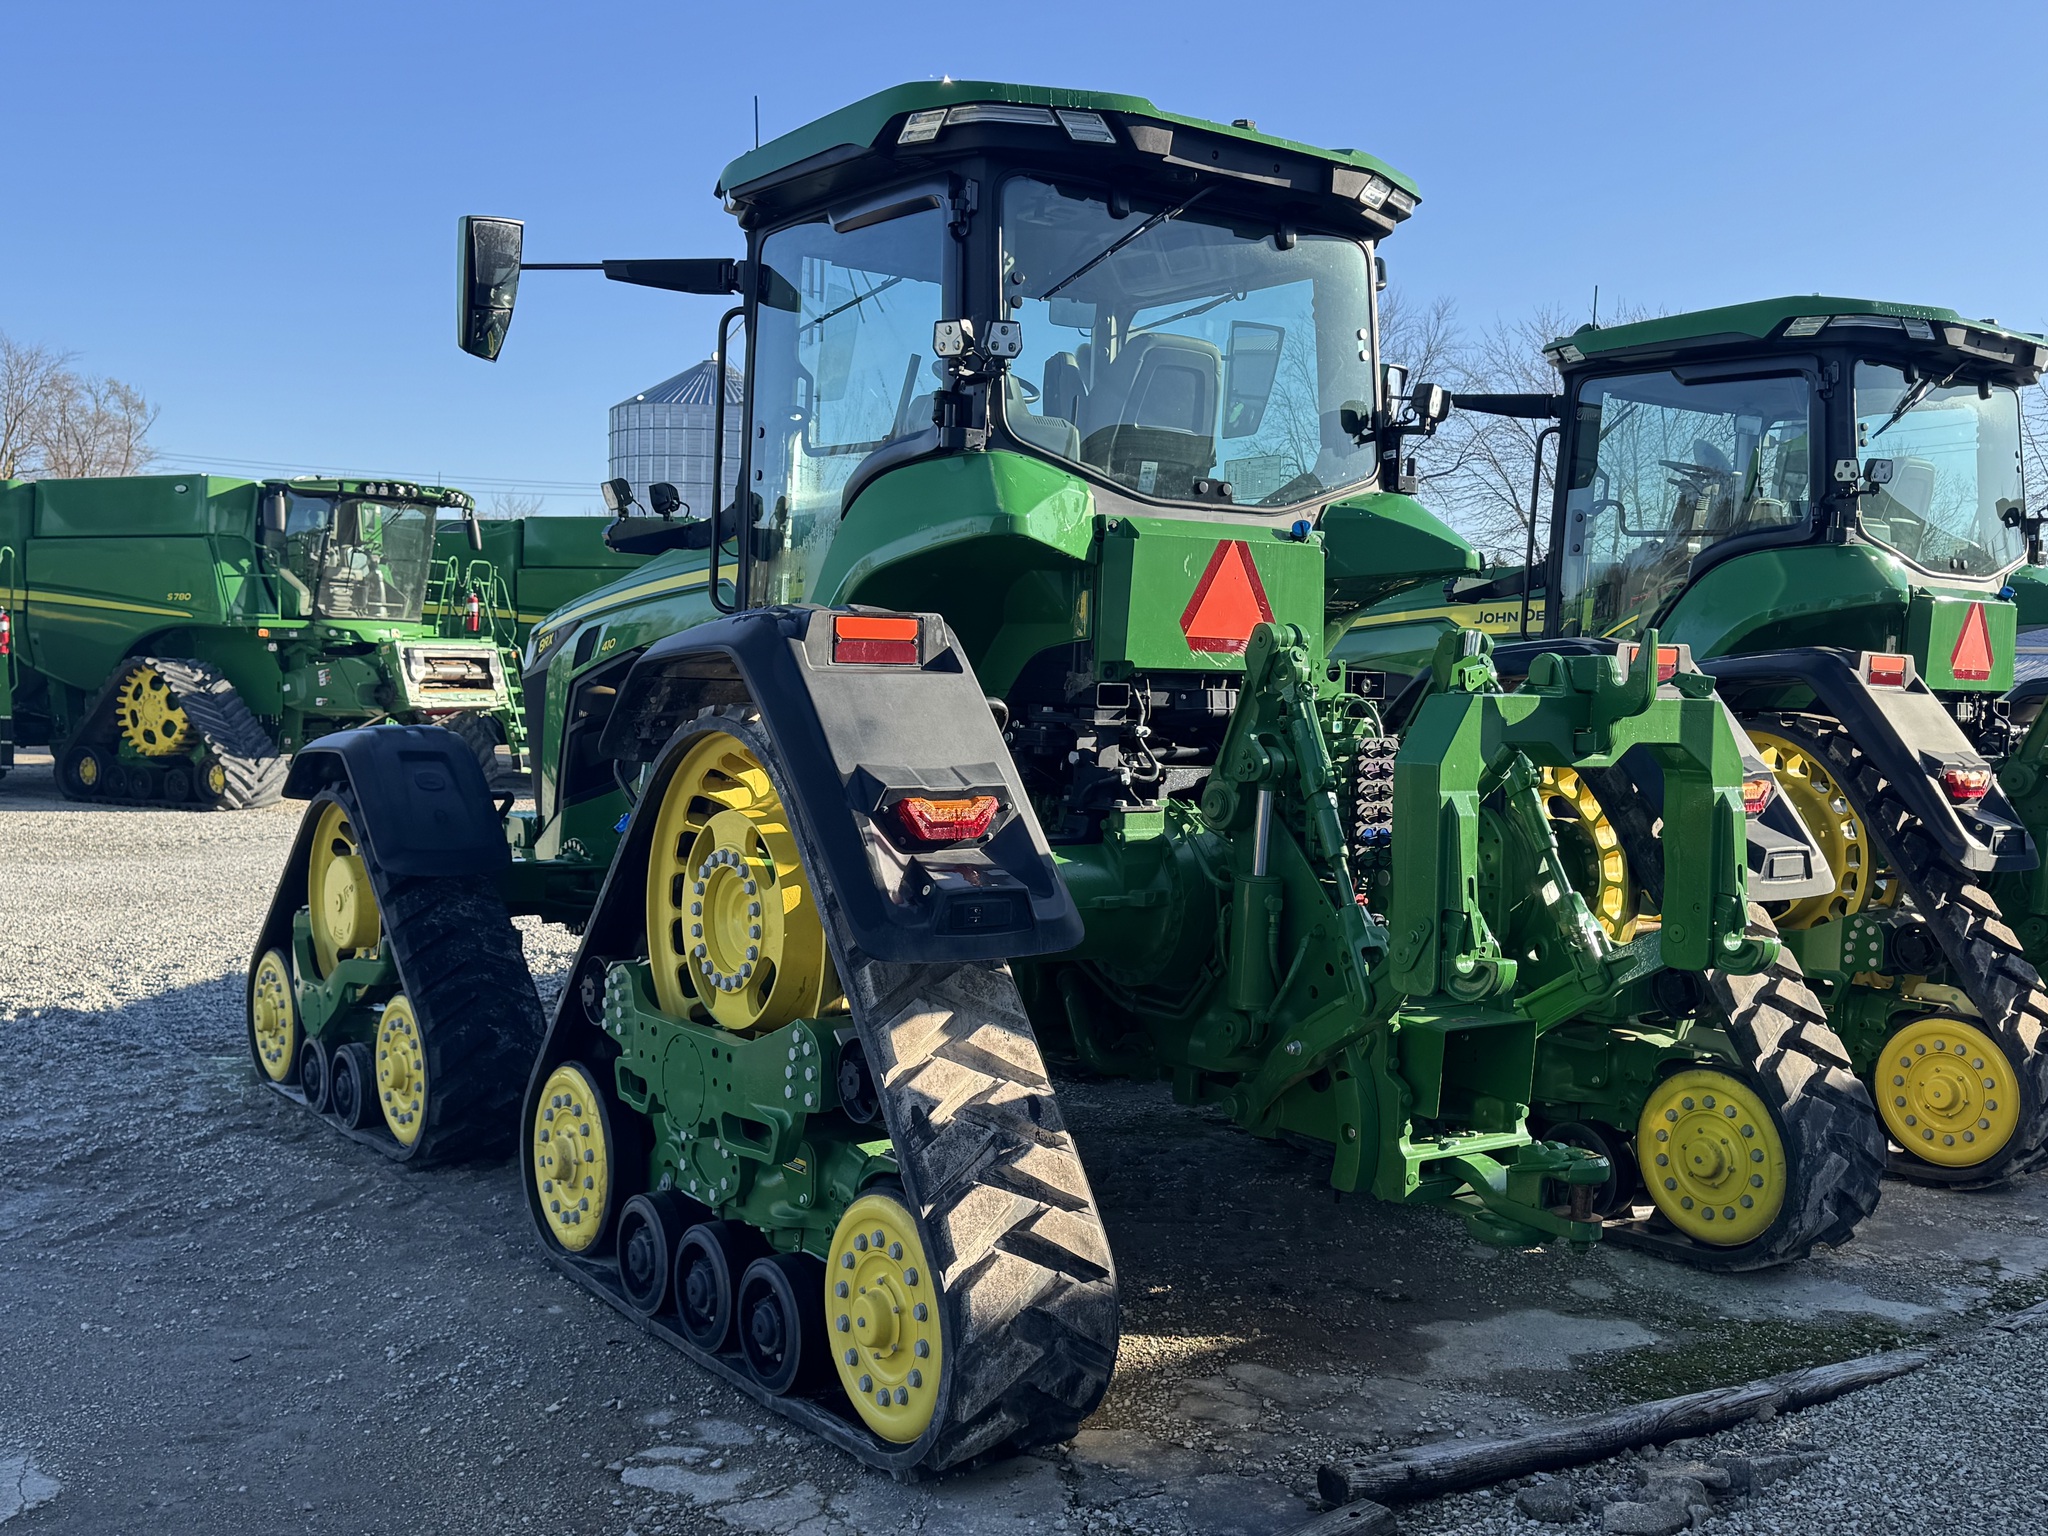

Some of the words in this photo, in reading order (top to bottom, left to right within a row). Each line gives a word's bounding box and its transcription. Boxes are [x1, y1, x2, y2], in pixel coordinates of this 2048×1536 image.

[166, 592, 192, 601] S780
[1474, 611, 1519, 624] JOHN
[538, 632, 554, 653] 8RX
[601, 637, 617, 652] 410
